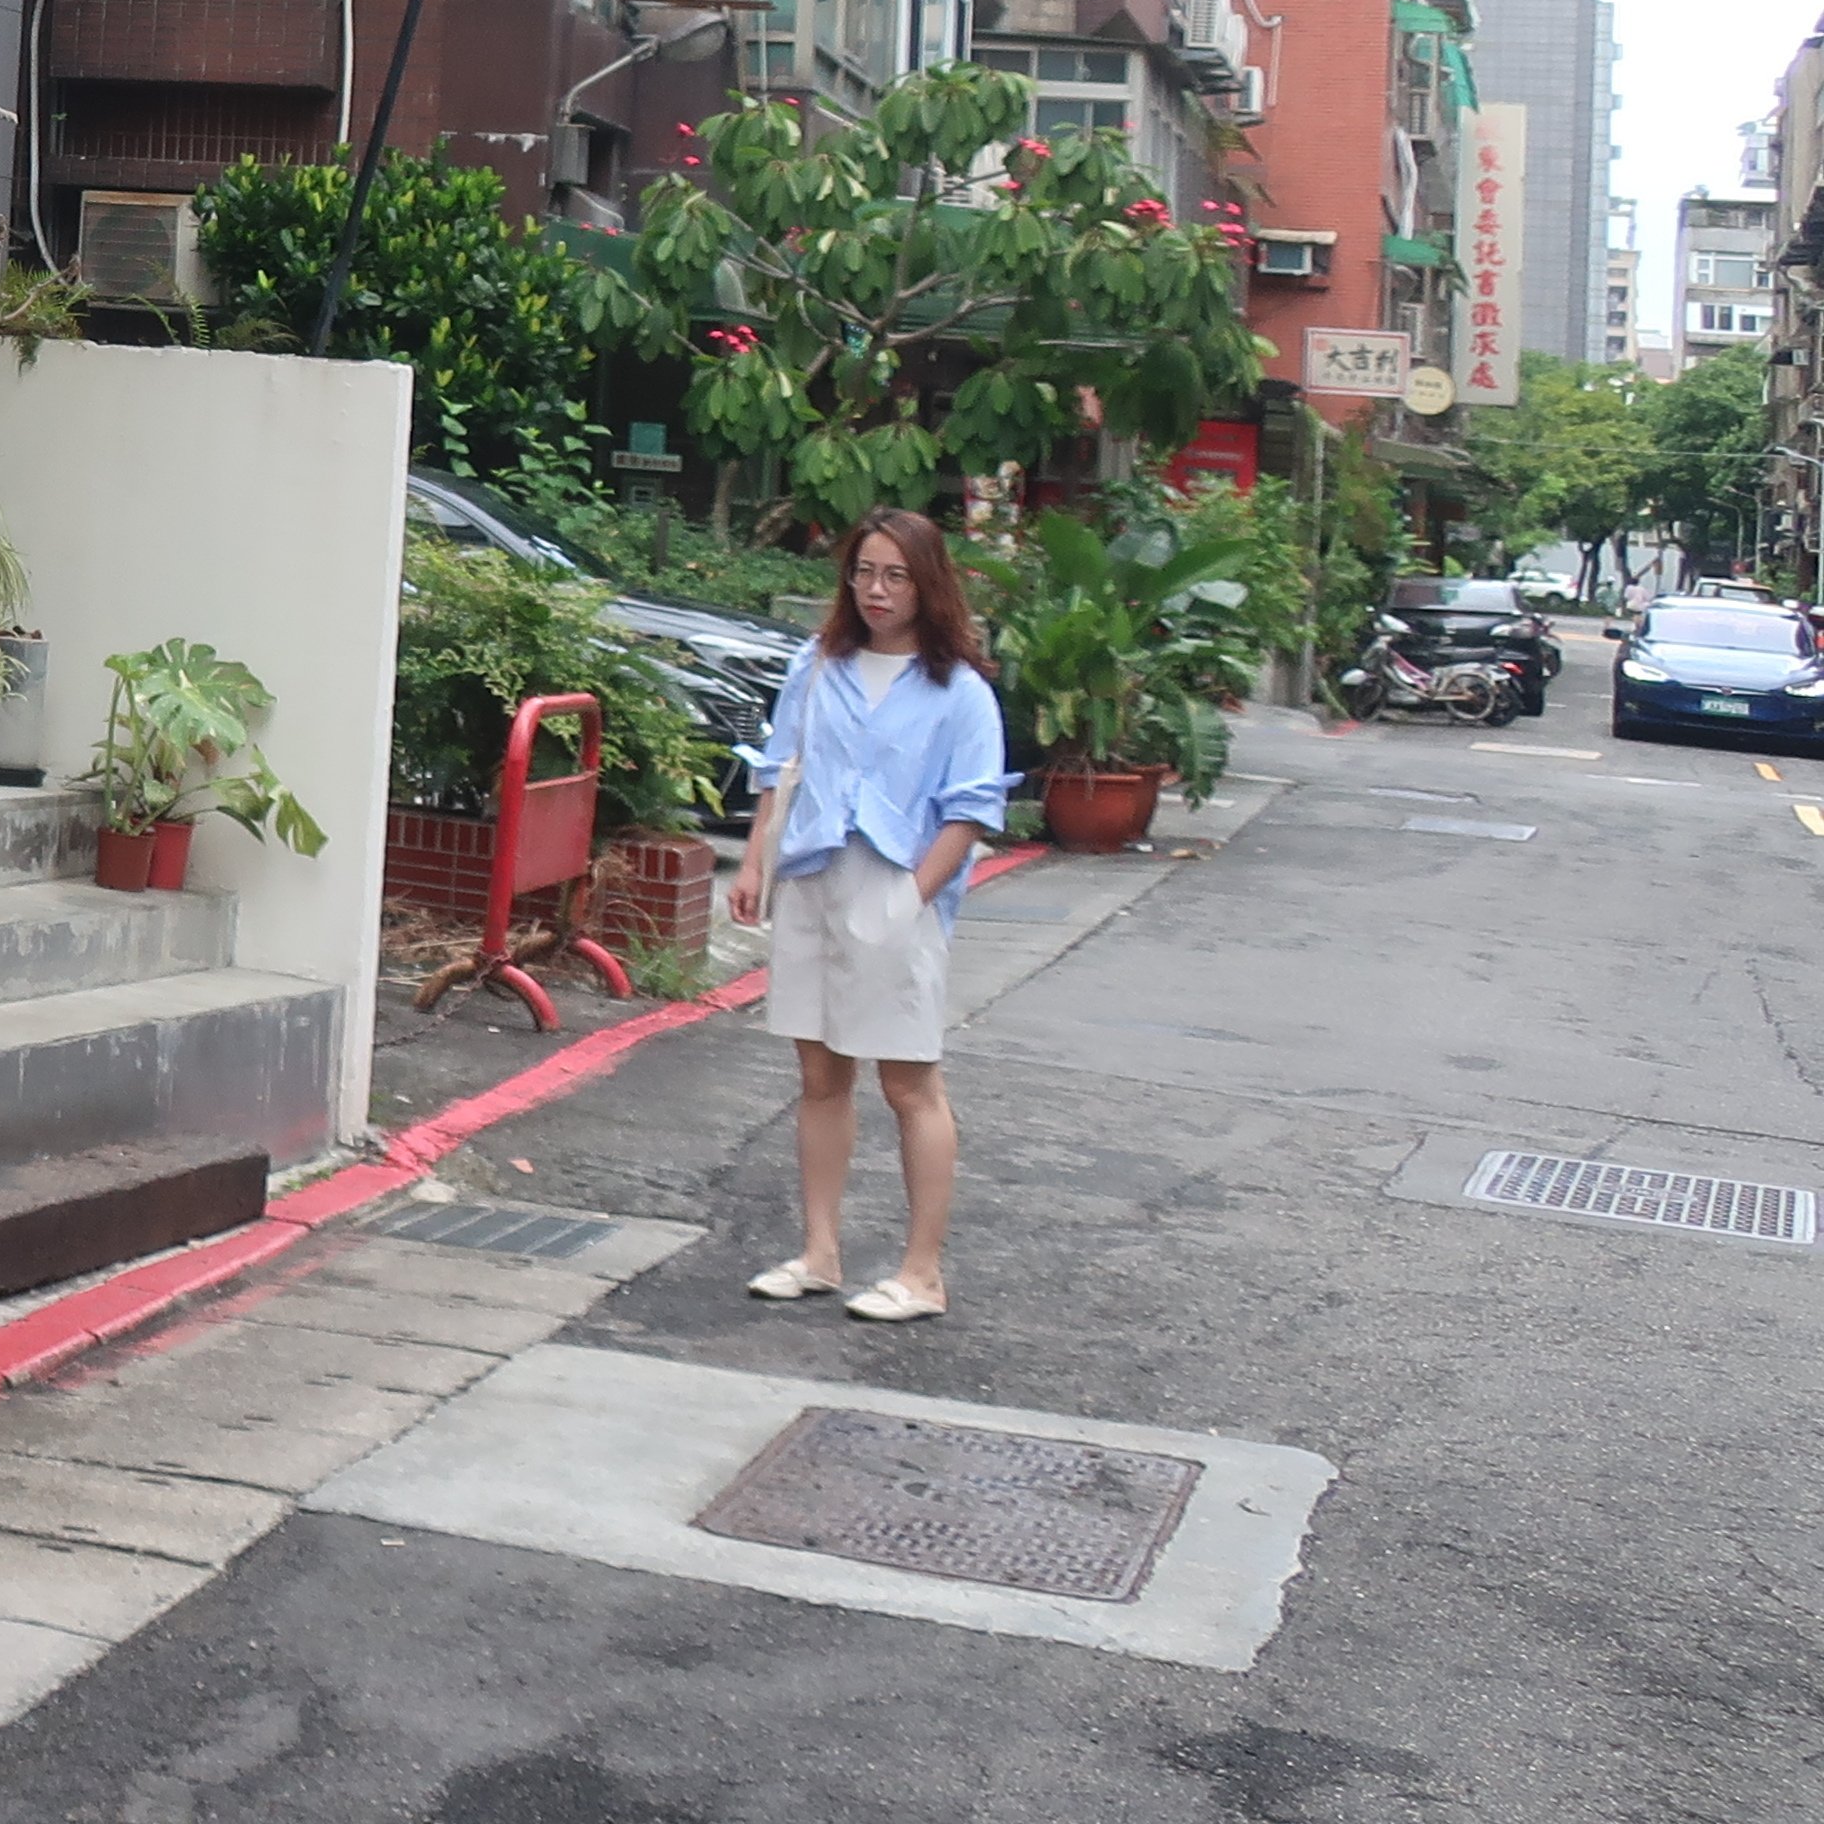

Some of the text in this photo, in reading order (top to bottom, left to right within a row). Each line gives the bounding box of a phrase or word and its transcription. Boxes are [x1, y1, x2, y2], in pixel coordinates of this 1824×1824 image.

[1466, 119, 1506, 389] 東會委託書徵求處
